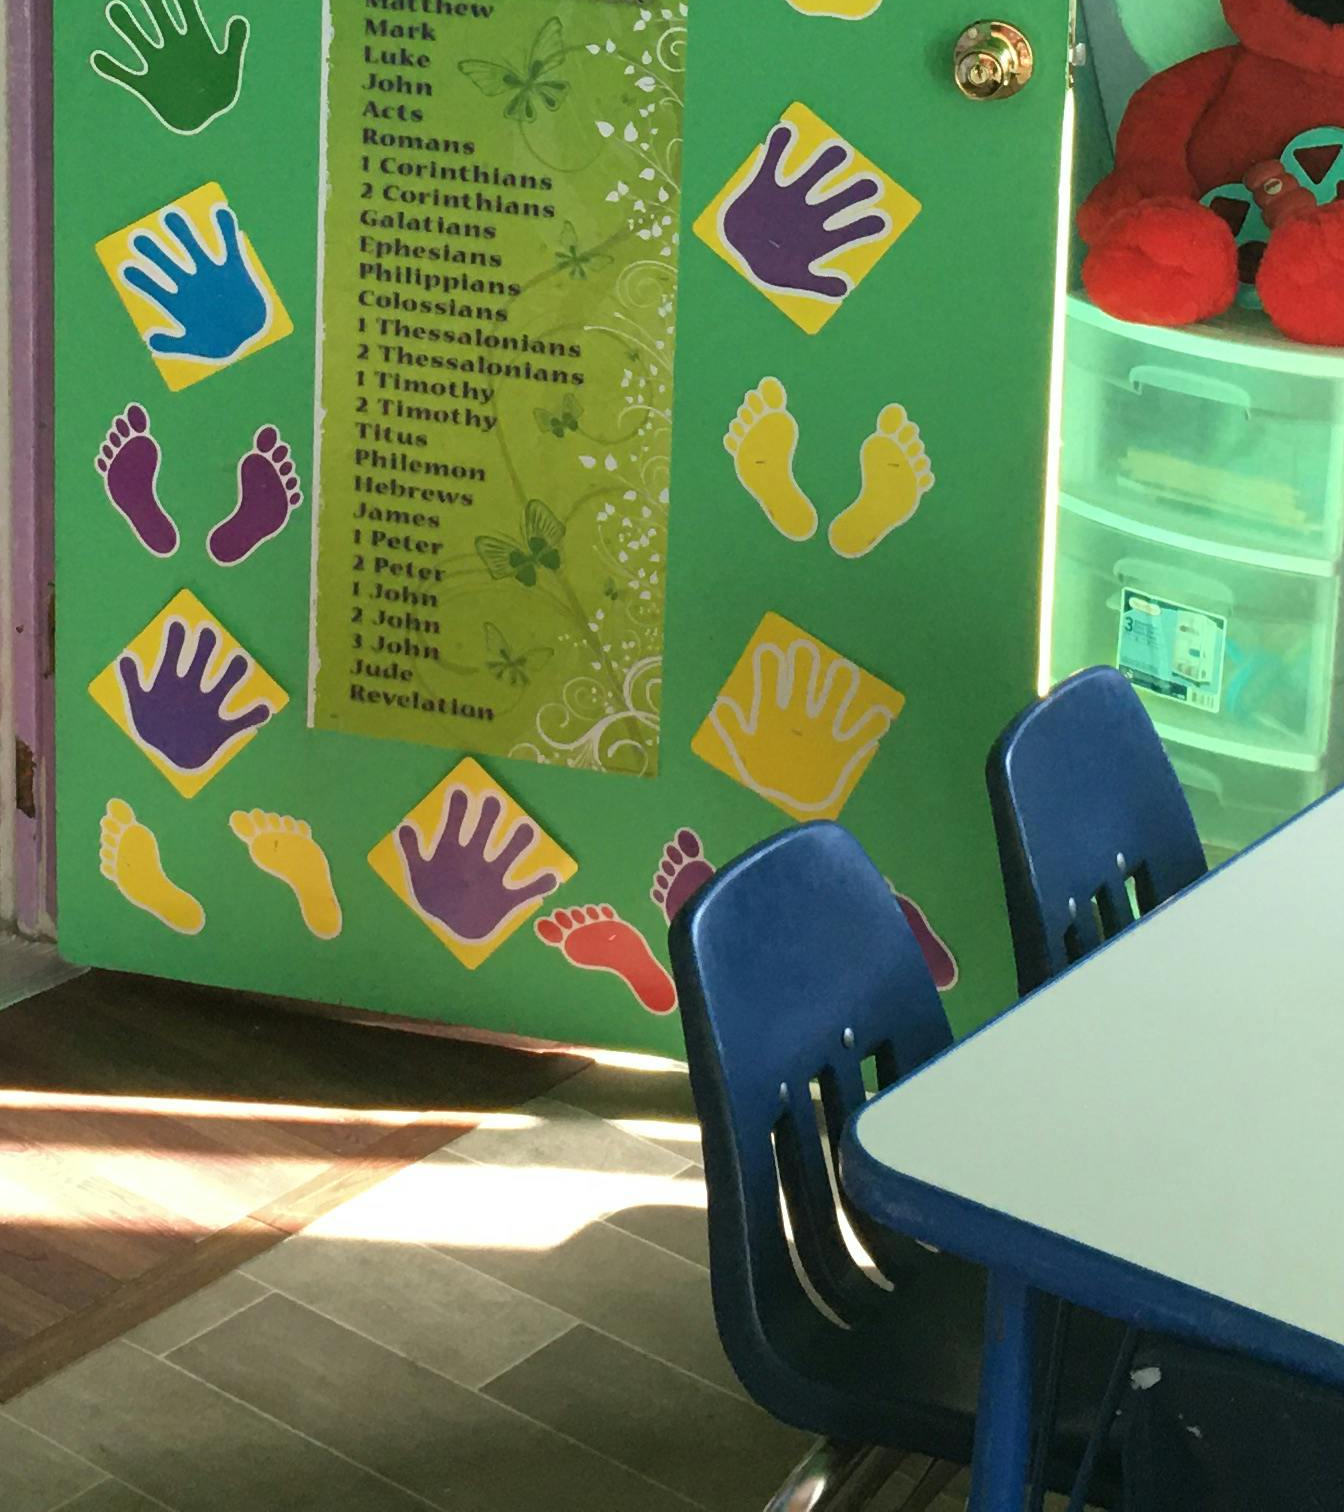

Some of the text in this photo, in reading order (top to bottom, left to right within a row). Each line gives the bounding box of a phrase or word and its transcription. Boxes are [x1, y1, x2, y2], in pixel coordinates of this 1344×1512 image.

[365, 18, 436, 40] Mark
[364, 46, 431, 68] Luke
[362, 73, 433, 96] John
[362, 100, 424, 122] Acts
[362, 127, 475, 155] Romans
[361, 156, 553, 190] 1 Corinthians
[360, 209, 497, 239] Galatians
[359, 236, 503, 267] Ephesians
[359, 262, 522, 297] Philippians
[358, 290, 508, 322] Colossians
[358, 317, 582, 358] 1 Thessalonians
[356, 370, 495, 404] 1 Timothy
[355, 422, 428, 447] Titus
[355, 449, 486, 482] Philemon
[354, 476, 474, 507] Hebrews
[353, 502, 440, 528] James
[353, 529, 444, 554] 1 Peter
[352, 582, 438, 607] 1 John
[350, 659, 414, 682] Jude
[350, 684, 495, 721] Revelation
